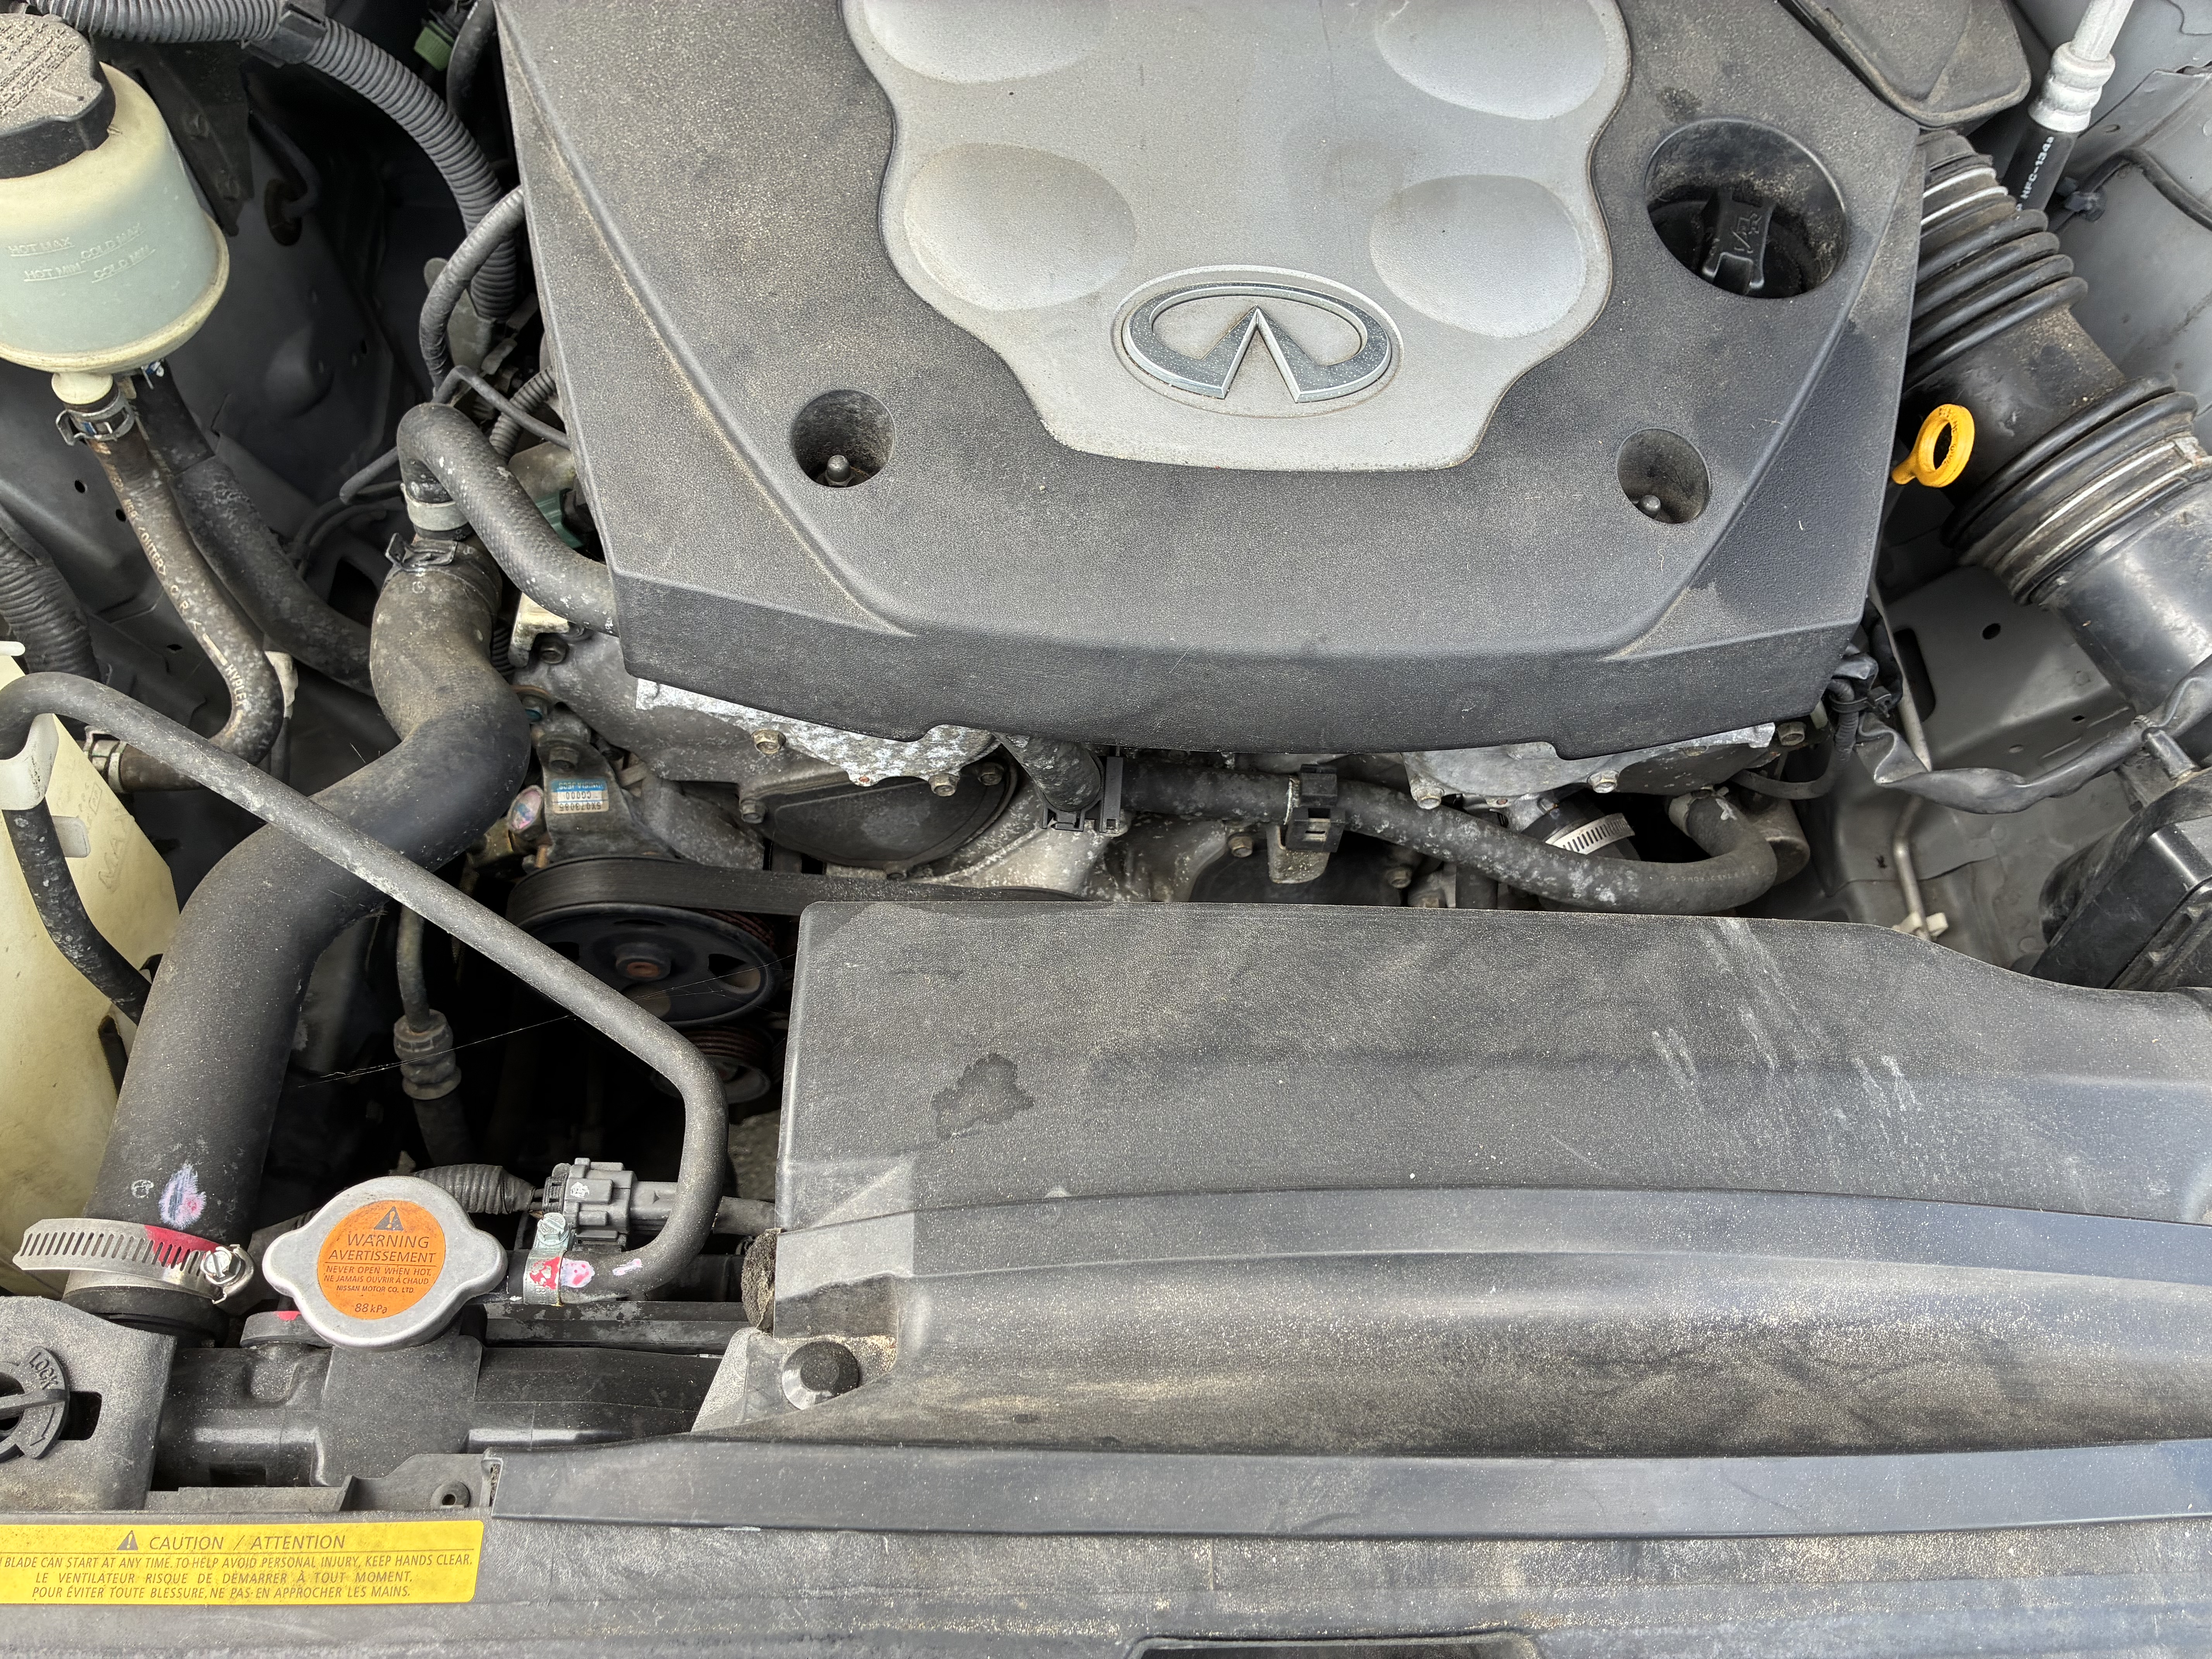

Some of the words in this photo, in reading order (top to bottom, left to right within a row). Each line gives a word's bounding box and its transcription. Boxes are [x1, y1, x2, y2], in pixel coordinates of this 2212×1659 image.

[8, 244, 36, 254] HOT
[24, 269, 53, 279] HOT
[348, 1233, 430, 1249] WARNING
[328, 1250, 438, 1263] AVERTISSEMENT
[385, 1267, 410, 1275] WHEN
[355, 1303, 369, 1312] 88
[370, 1304, 387, 1314] kPa
[29, 1352, 59, 1390] LOCK
[150, 1536, 223, 1550] CAUTION
[250, 1535, 345, 1550] ATTENTION
[5, 1557, 38, 1568] BLADE
[41, 1557, 62, 1568] CAN
[67, 1557, 98, 1568] START
[101, 1557, 116, 1568] AT
[119, 1558, 142, 1568] ANY
[176, 1558, 189, 1568] TO
[192, 1558, 219, 1568] HELP
[222, 1557, 257, 1568] AVOID
[261, 1556, 316, 1568] PERSONAL
[321, 1556, 361, 1568] INJURY,
[366, 1555, 392, 1567] KEEP
[395, 1554, 433, 1566] HANDS
[436, 1554, 472, 1565] CLEAR.
[36, 1572, 48, 1583] LE
[59, 1573, 135, 1583] VENTILATEUR
[146, 1573, 188, 1585] RISQUE
[198, 1573, 213, 1584] DE
[314, 1572, 346, 1583] TOUT
[355, 1571, 412, 1583] MOMENT.
[33, 1587, 62, 1597] POUR
[67, 1585, 105, 1598] ÉVITER
[110, 1587, 145, 1598] TOUTE
[210, 1588, 225, 1599] NE
[230, 1587, 250, 1599] PAS
[256, 1587, 270, 1599] EN
[273, 1587, 342, 1599] APPROCHER
[347, 1586, 366, 1597] LES
[371, 1585, 410, 1597] MAINS.
